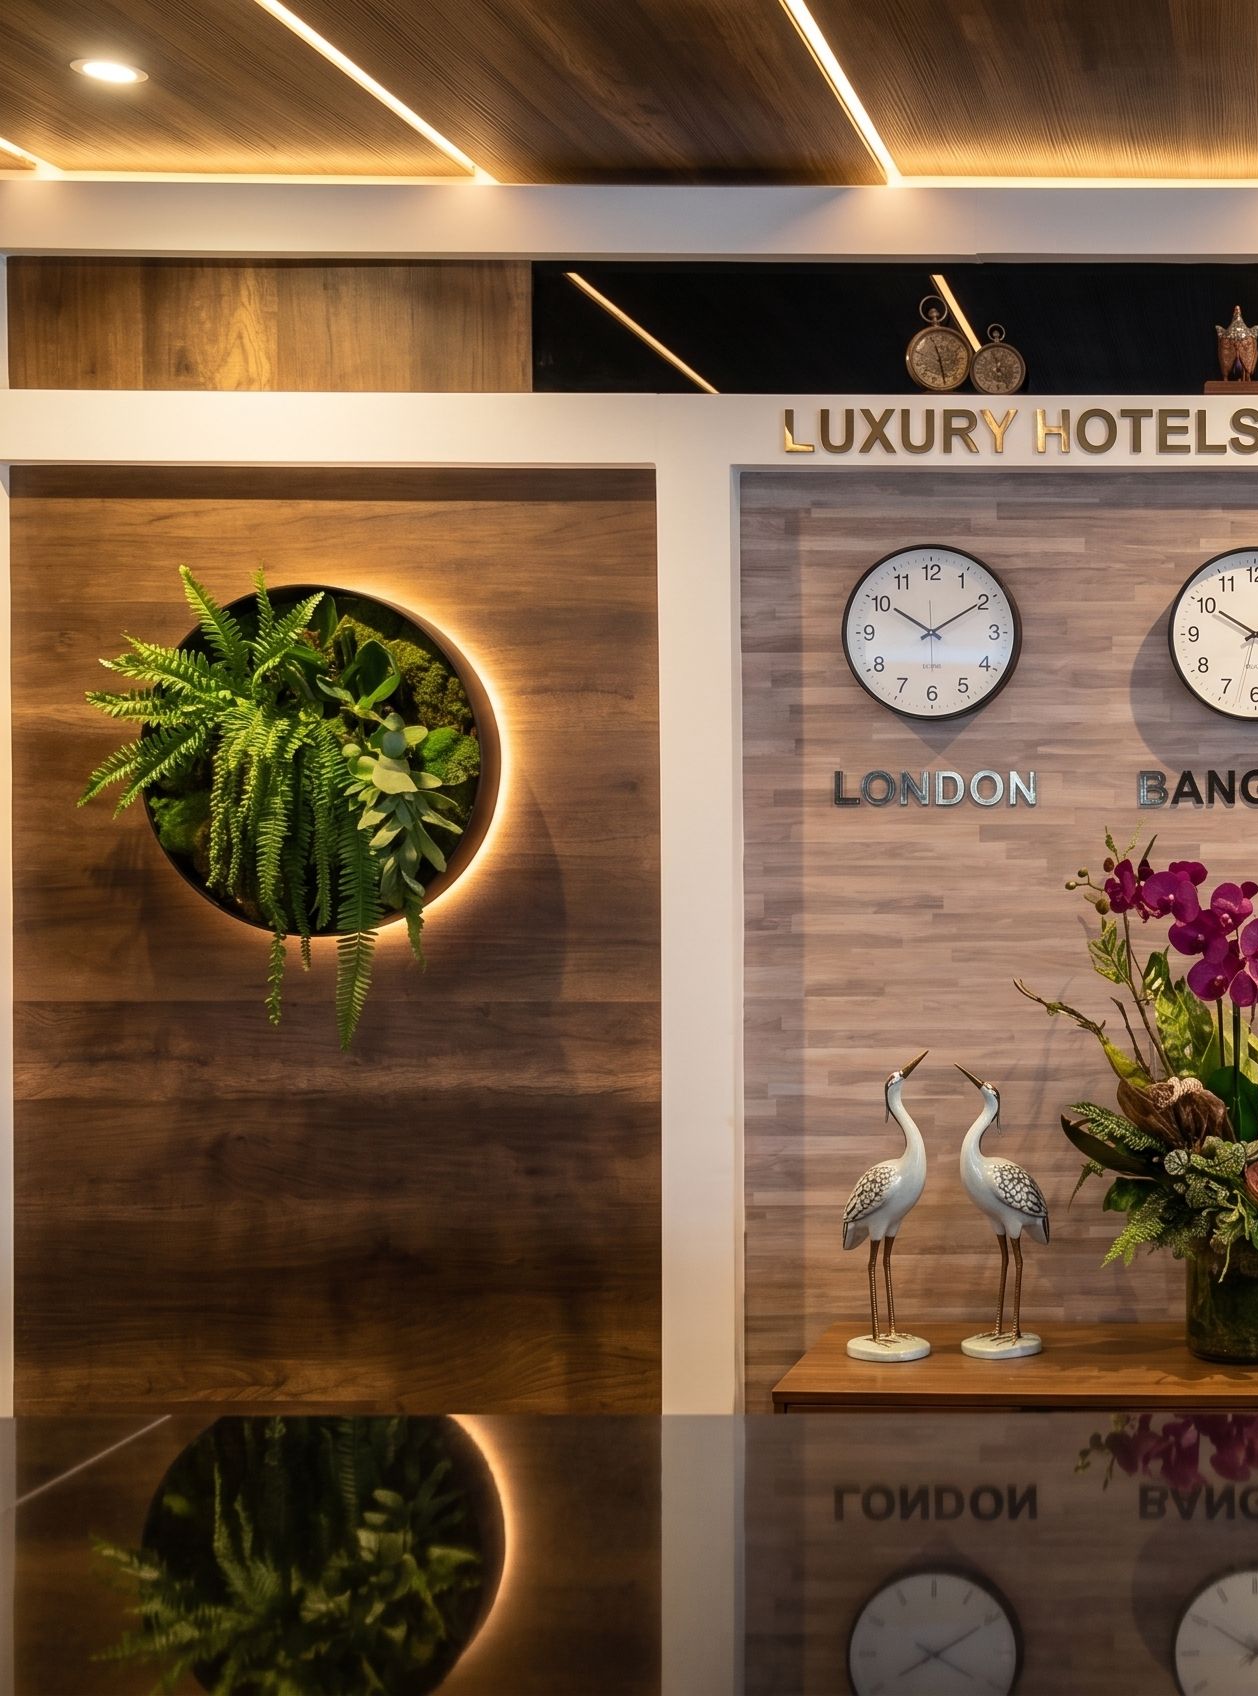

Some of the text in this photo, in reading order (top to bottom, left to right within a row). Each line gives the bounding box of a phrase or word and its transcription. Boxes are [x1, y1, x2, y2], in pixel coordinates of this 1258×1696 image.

[784, 408, 1018, 454] LUXURY
[921, 564, 942, 580] 12
[958, 572, 965, 589] 1
[894, 574, 909, 590] 11
[1218, 575, 1234, 592] 11
[871, 595, 891, 612] 10
[977, 593, 989, 610] 2
[1196, 597, 1216, 614] 10
[863, 624, 875, 641] 9
[988, 624, 1000, 640] 3
[1188, 625, 1200, 642] 9
[873, 656, 885, 672] 8
[978, 655, 991, 672] 4
[1197, 656, 1209, 673] 8
[896, 677, 908, 693] 7
[926, 685, 938, 701] 6
[957, 677, 969, 693] 5
[1220, 678, 1232, 694] 7
[834, 770, 1037, 806] LONDON
